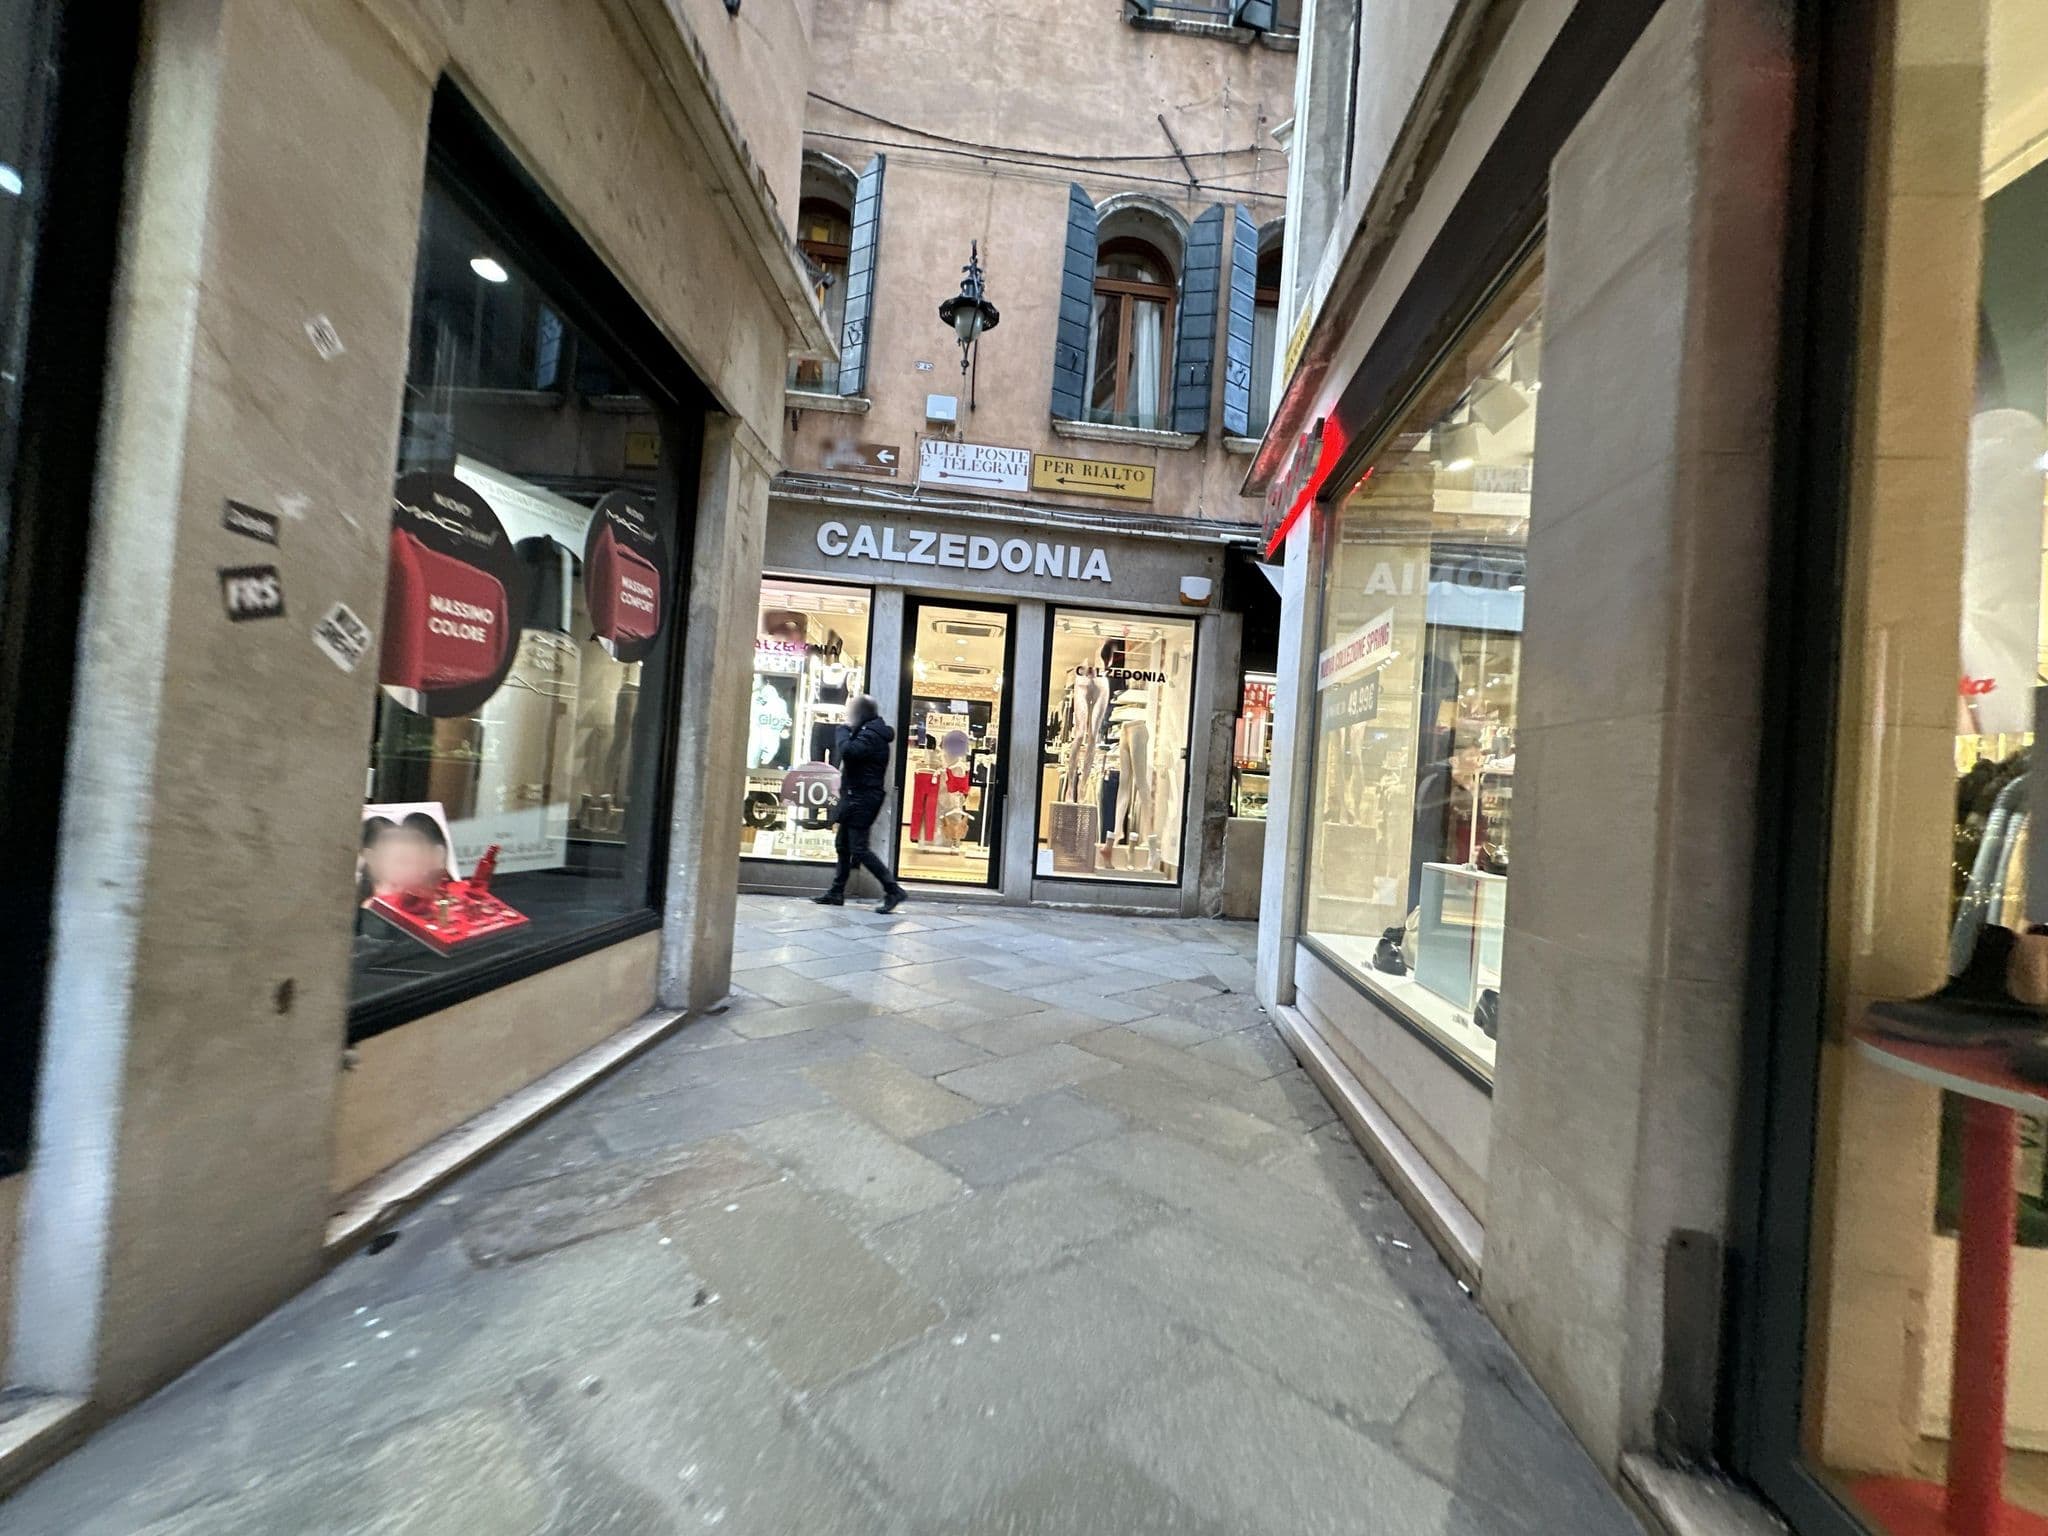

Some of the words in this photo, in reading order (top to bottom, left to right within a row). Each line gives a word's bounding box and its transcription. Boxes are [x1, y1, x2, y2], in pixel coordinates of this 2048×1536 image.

[921, 441, 966, 458] ALLE
[976, 444, 1028, 464] POSTE
[921, 453, 931, 468] E
[943, 456, 1028, 477] TELEGRAFI
[1043, 460, 1074, 475] PER
[1082, 464, 1145, 482] RIALTO
[816, 521, 1112, 583] CALZEDONIA
[429, 594, 495, 625] MASSIMO
[428, 617, 488, 644] COLORE
